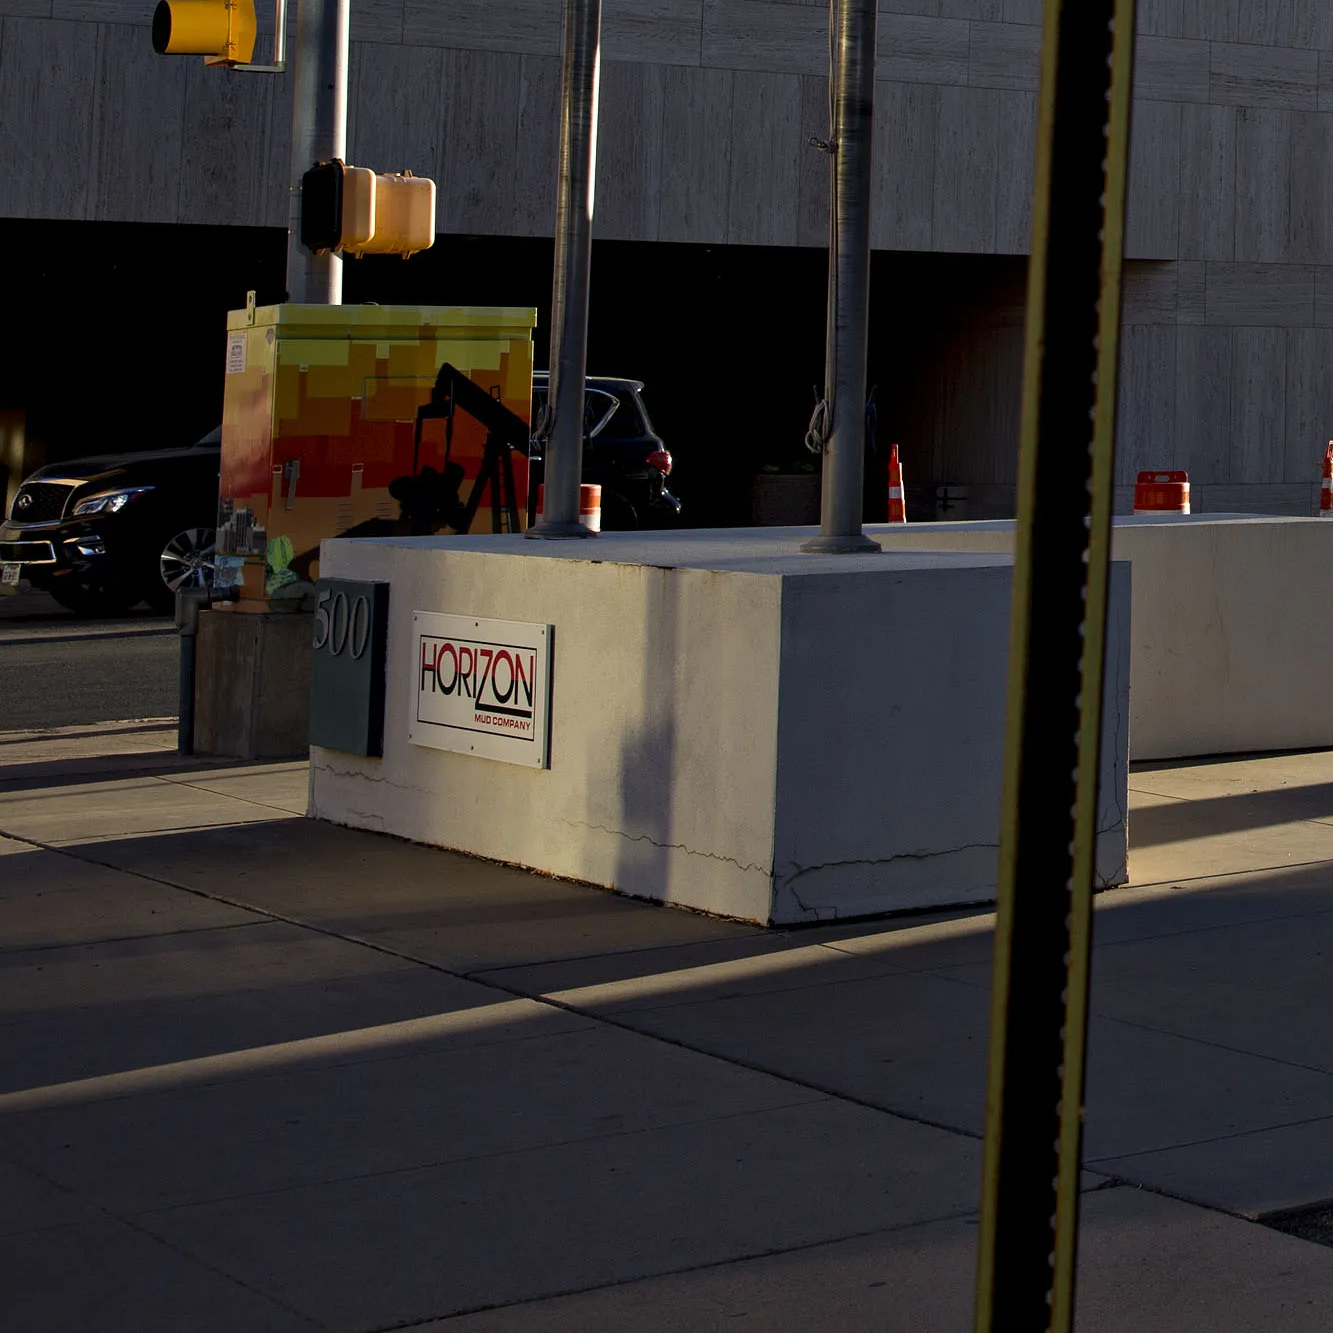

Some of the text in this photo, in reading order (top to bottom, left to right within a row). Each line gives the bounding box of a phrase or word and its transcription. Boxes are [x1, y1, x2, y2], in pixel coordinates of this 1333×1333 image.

[312, 589, 370, 660] 500
[420, 641, 534, 718] HORIZON
[474, 713, 532, 731] MUD COMPANY
